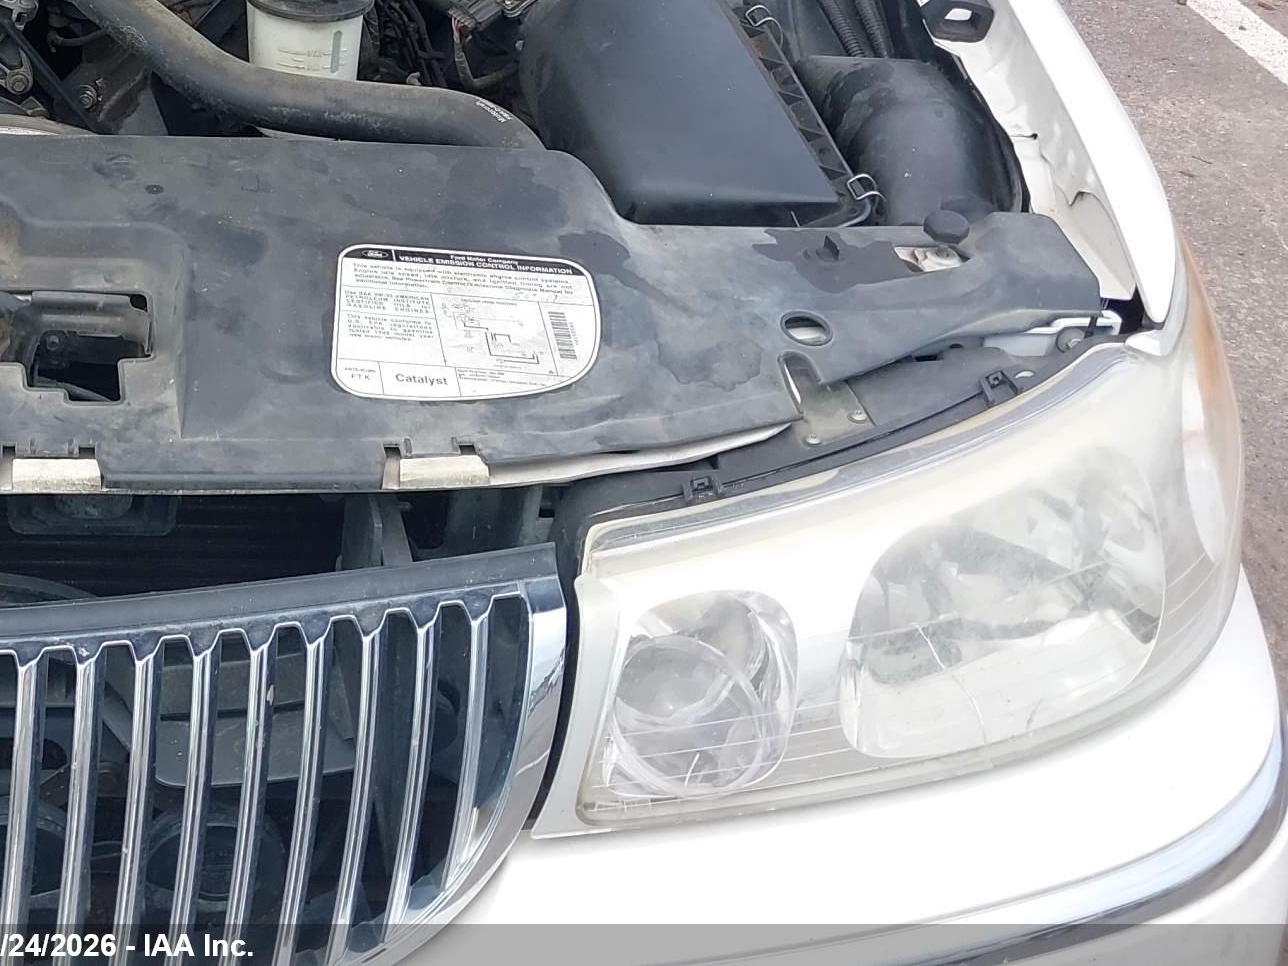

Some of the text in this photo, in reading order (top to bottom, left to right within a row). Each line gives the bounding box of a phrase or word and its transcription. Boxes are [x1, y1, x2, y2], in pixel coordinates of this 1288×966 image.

[399, 256, 573, 274] VEHICLE EMISSION CONTROL INFORMATION
[396, 373, 448, 386] Catalyst
